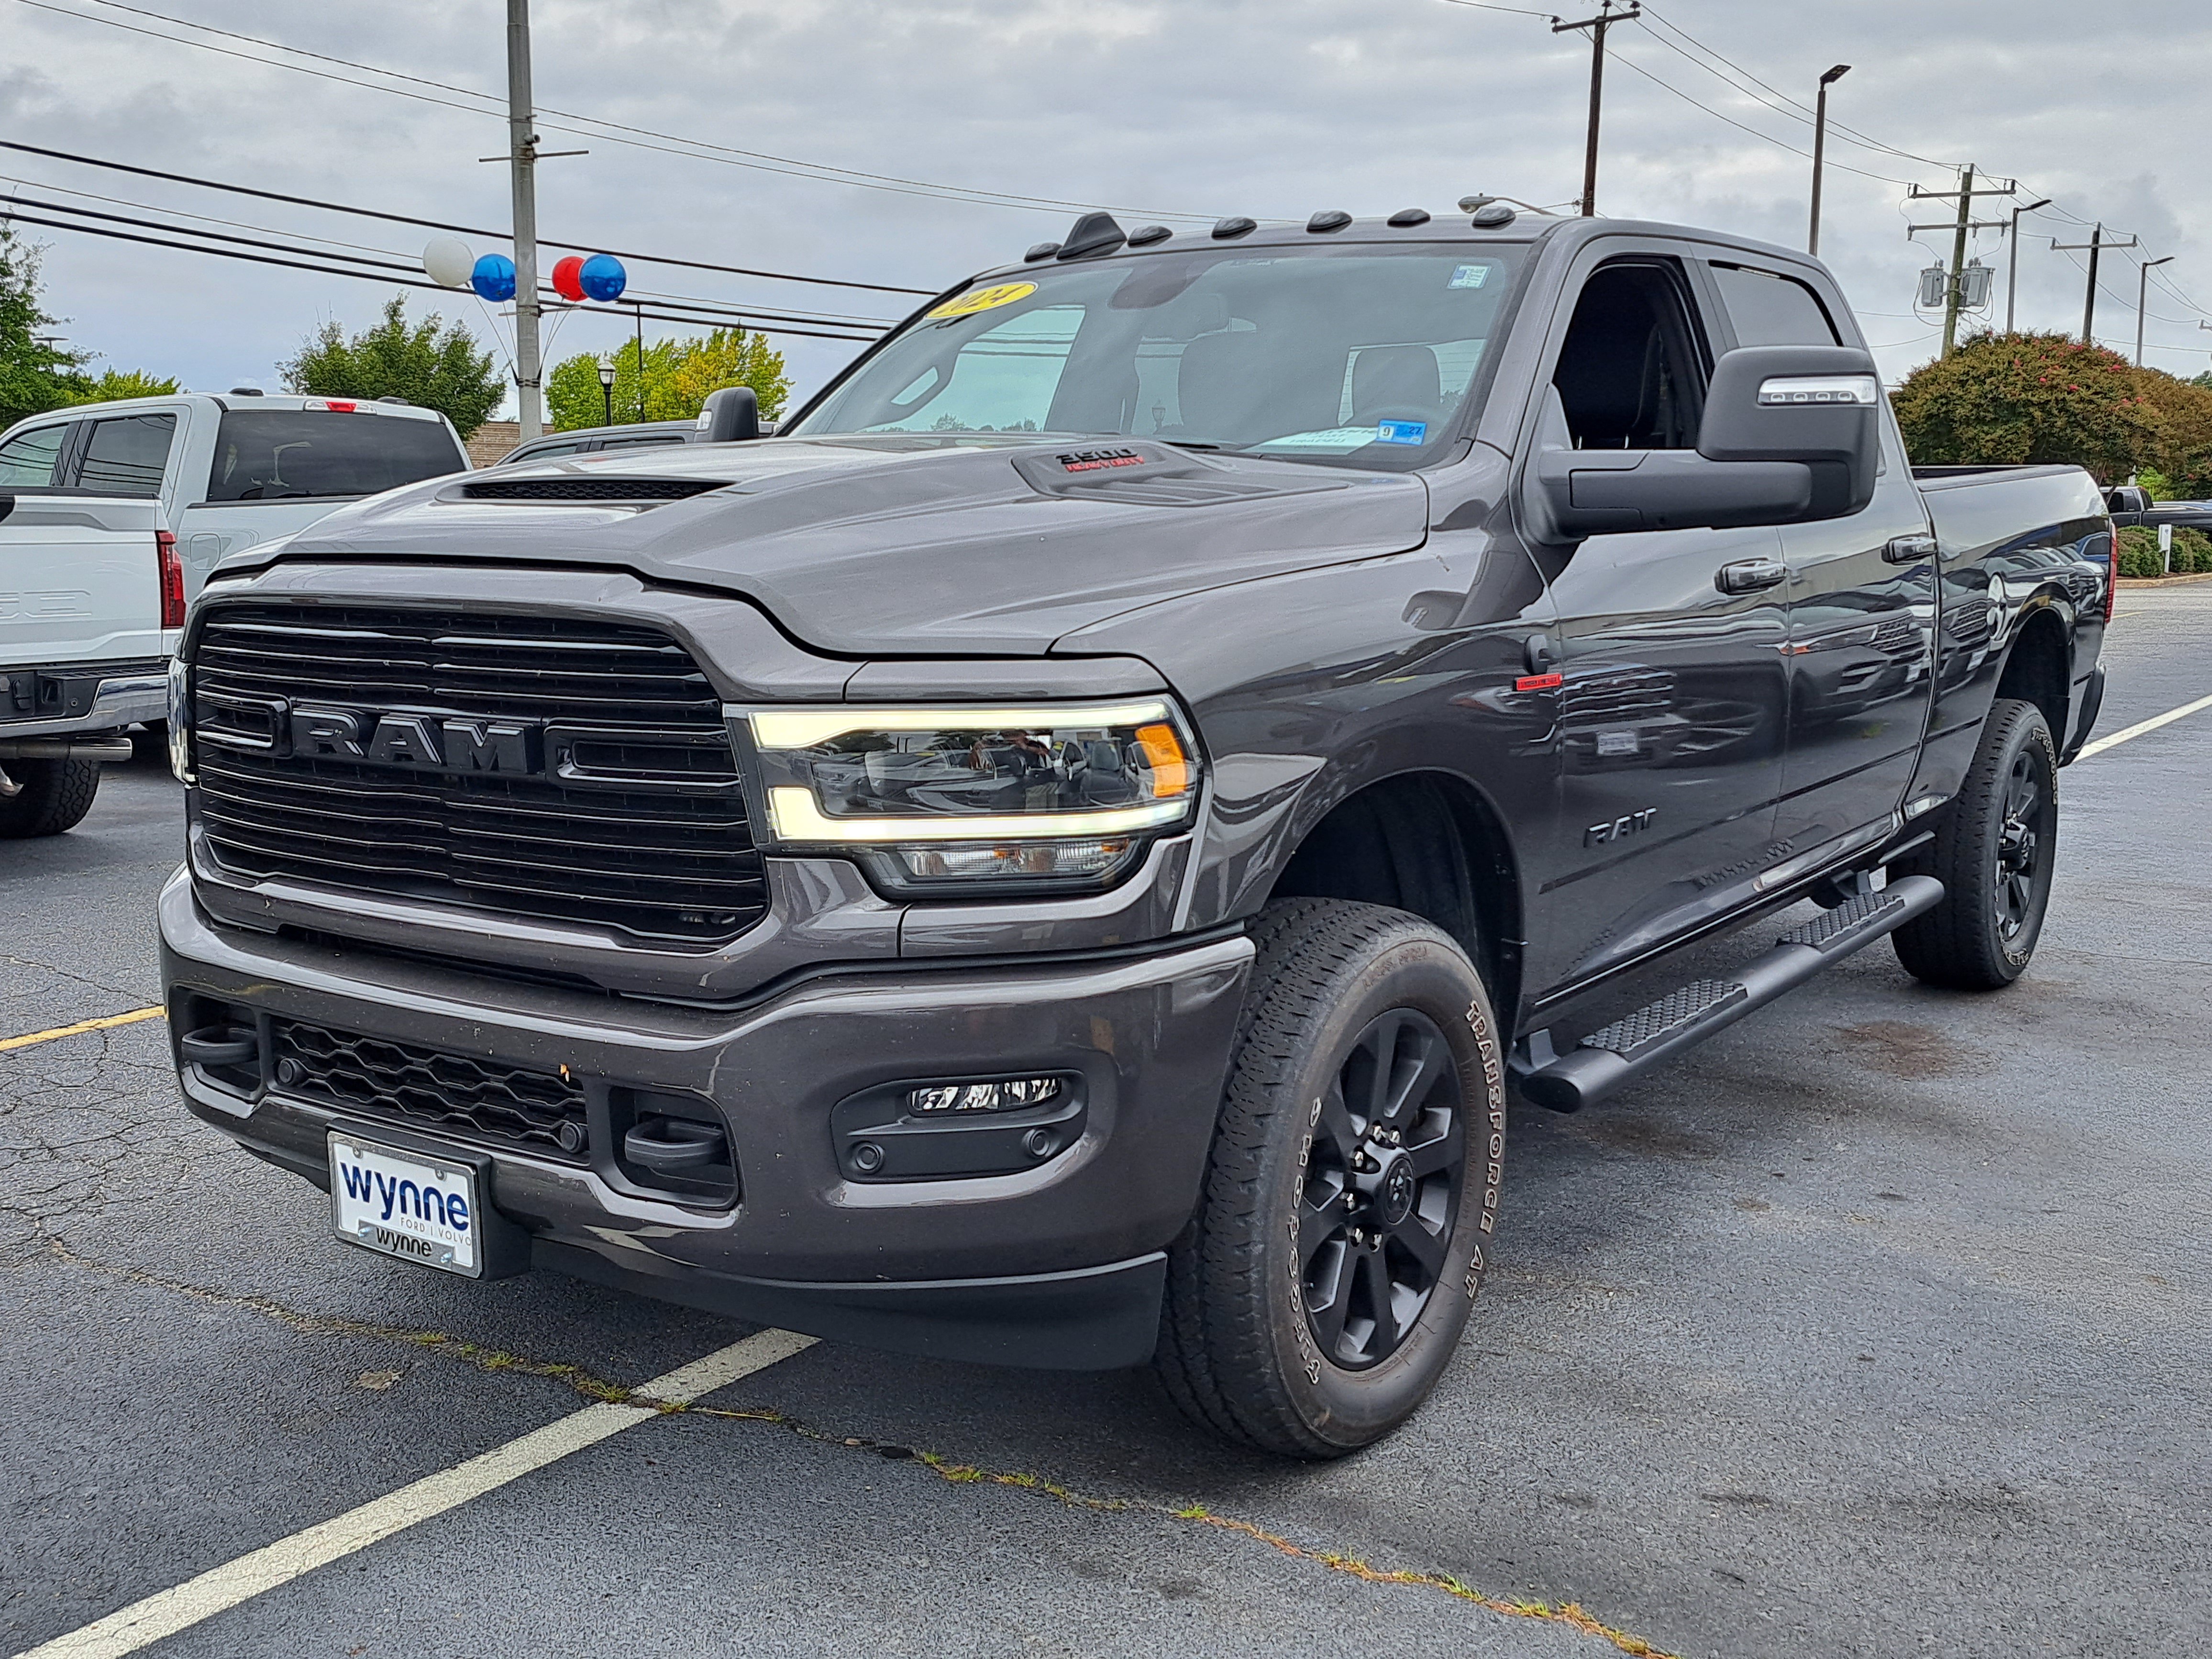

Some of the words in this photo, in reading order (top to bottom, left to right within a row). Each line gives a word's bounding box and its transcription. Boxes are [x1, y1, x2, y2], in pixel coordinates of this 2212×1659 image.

[1382, 426, 1391, 436] 9
[1408, 426, 1422, 435] 27
[290, 708, 541, 774] RAM
[1464, 999, 1503, 1234] TRANSFORCE
[340, 1161, 470, 1231] wynne
[376, 1227, 432, 1257] wynne
[400, 1217, 425, 1232] FORD
[438, 1227, 471, 1247] VOLVO
[1465, 1244, 1484, 1300] AT
